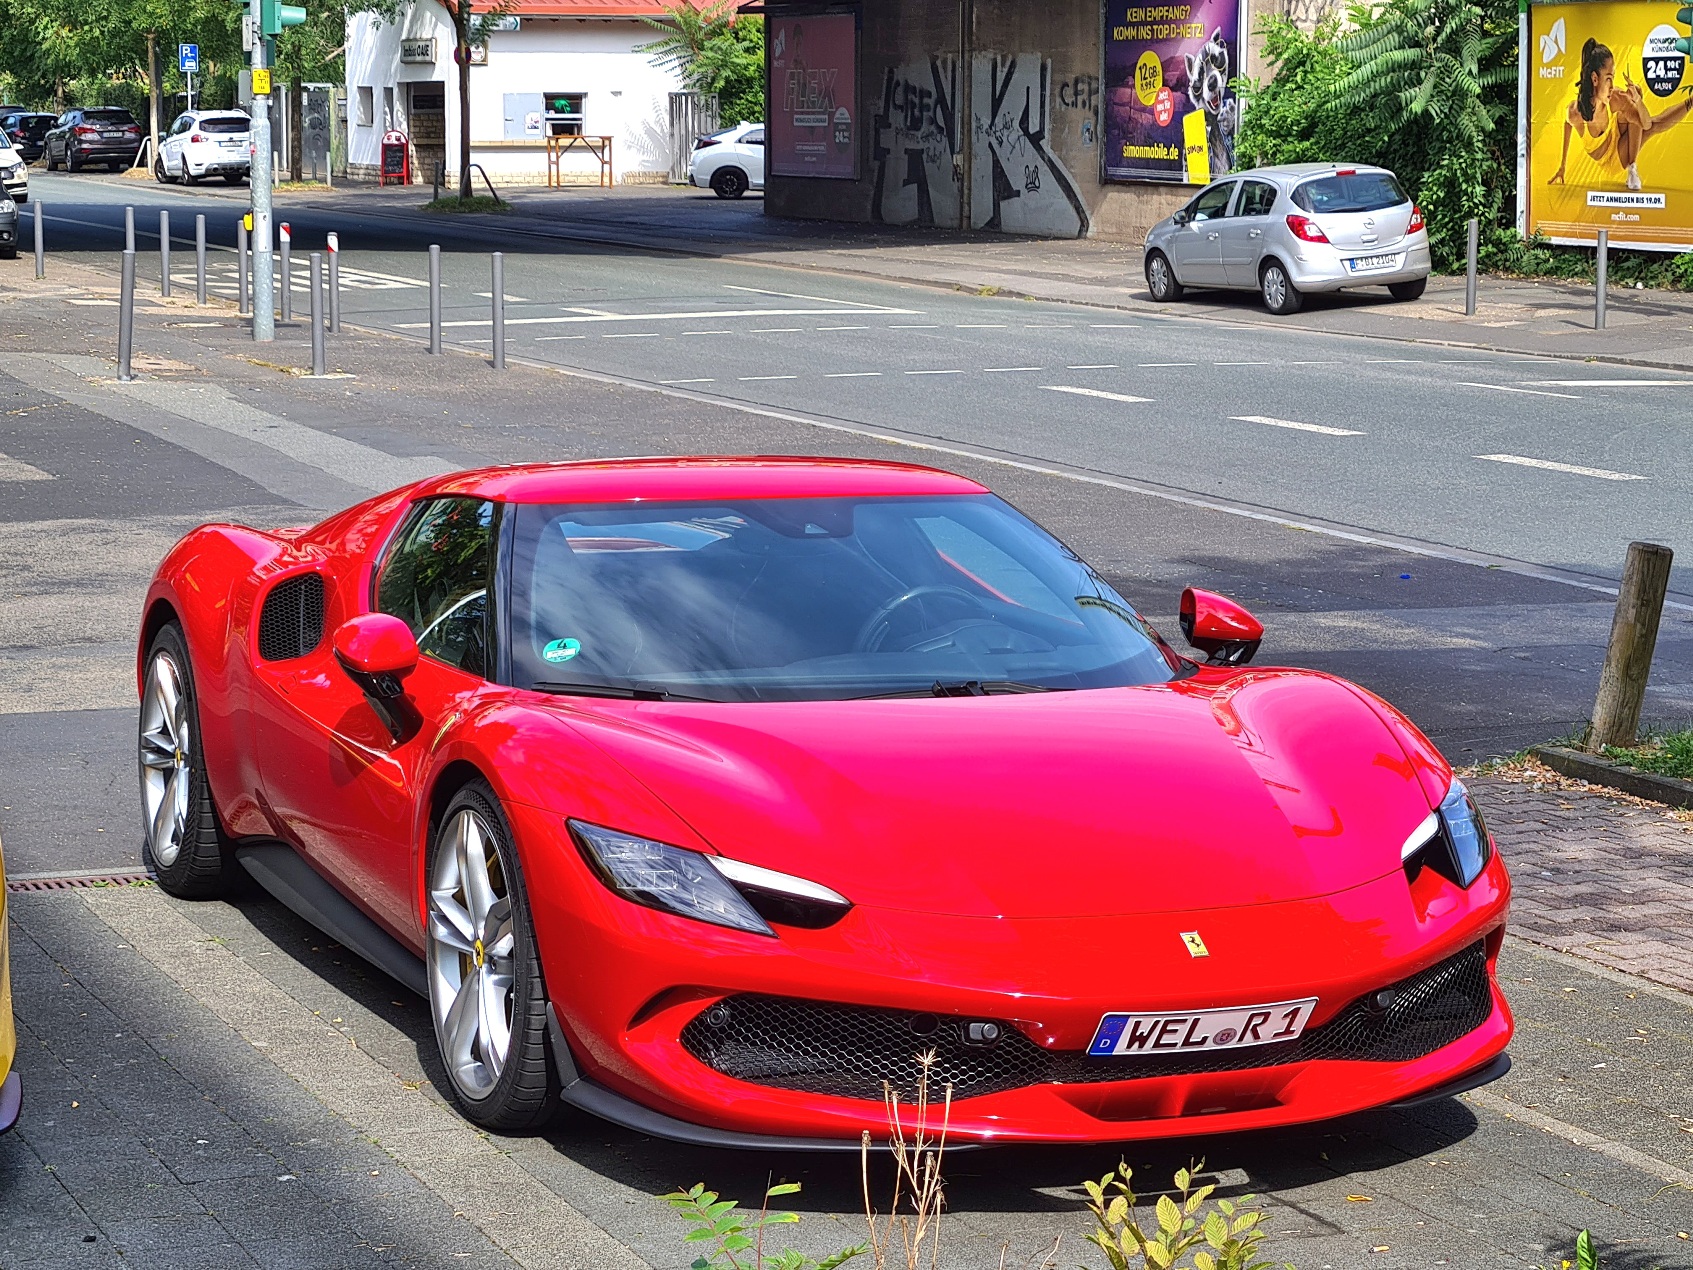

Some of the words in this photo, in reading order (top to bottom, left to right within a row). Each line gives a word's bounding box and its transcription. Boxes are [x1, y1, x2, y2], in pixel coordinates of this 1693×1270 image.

[1127, 8, 1145, 22] KEIN
[1146, 5, 1191, 21] EMPFANG?
[1113, 26, 1137, 40] KOMM
[1138, 25, 1152, 39] INS
[1153, 24, 1169, 39] TOP
[1170, 23, 1204, 38] D-NETZ!
[182, 46, 191, 57] P
[1139, 62, 1148, 82] 12
[1539, 66, 1565, 78] McFIT
[783, 69, 839, 112] FLEX
[1122, 141, 1179, 160] simonmobile.de
[1590, 195, 1605, 203] JETZT
[1605, 195, 1635, 204] ANMELDEN
[1636, 196, 1645, 204] BIS
[1611, 211, 1640, 222] mcfit.com
[557, 639, 567, 650] 4
[1099, 1038, 1111, 1048] D
[1124, 1016, 1210, 1051] WEL
[1236, 1010, 1273, 1044] R
[1272, 1004, 1304, 1039] 1
